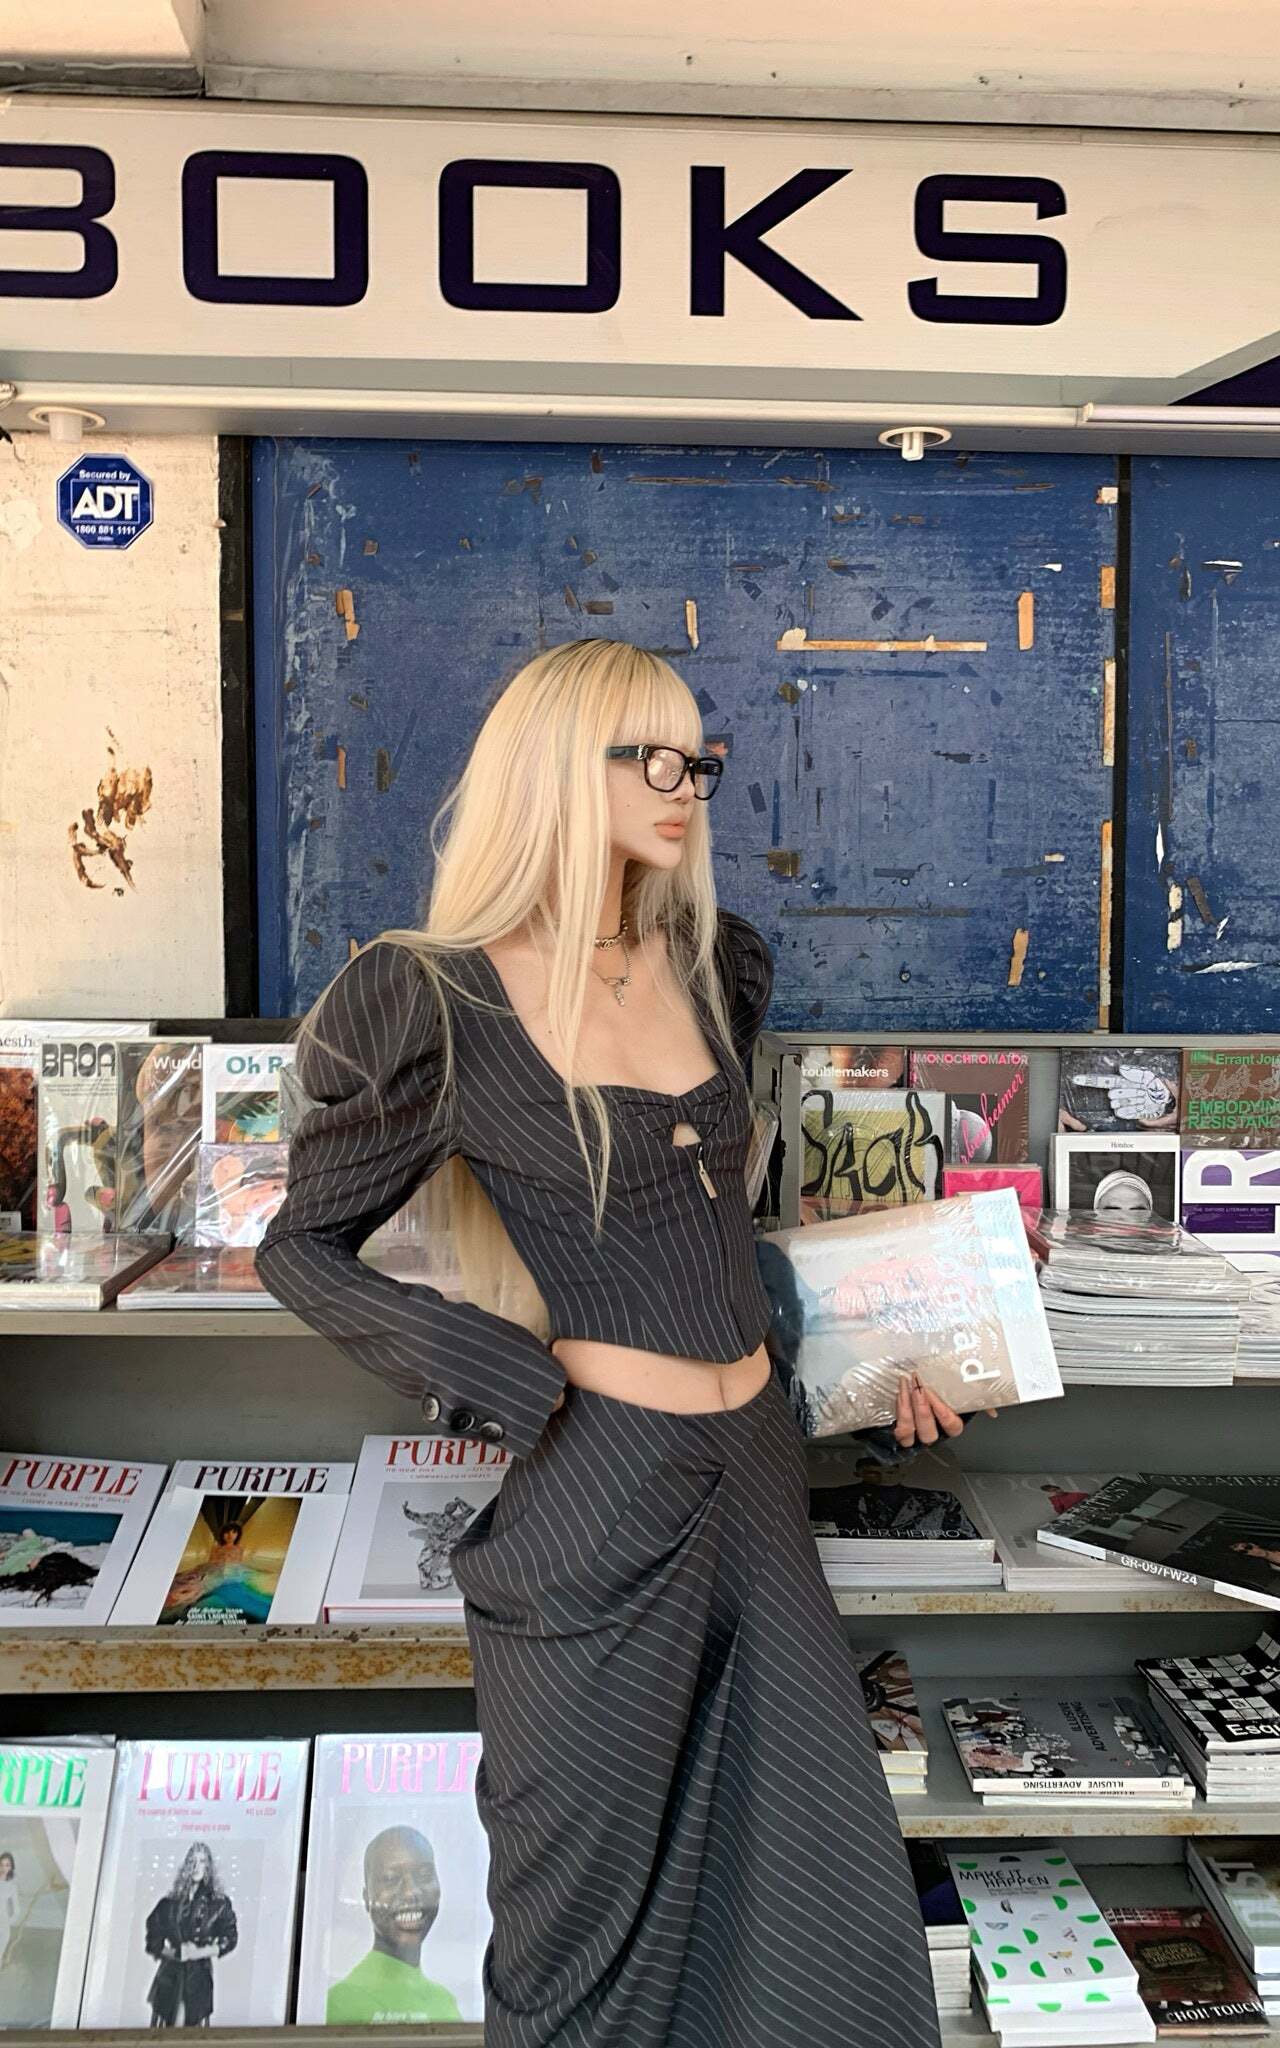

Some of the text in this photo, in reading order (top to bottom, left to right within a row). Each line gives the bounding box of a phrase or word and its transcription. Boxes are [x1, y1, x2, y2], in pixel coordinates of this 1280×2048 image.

[0, 144, 1068, 326] BOOKS
[79, 470, 131, 481] Secured by
[72, 486, 139, 519] ADT
[226, 1056, 260, 1074] Oh
[1215, 1054, 1255, 1065] Errant
[0, 1458, 143, 1496] PURPLE
[193, 1465, 329, 1493] PURPLE
[898, 1529, 960, 1538] HERRO
[1023, 1781, 1081, 1789] ADVERTISING
